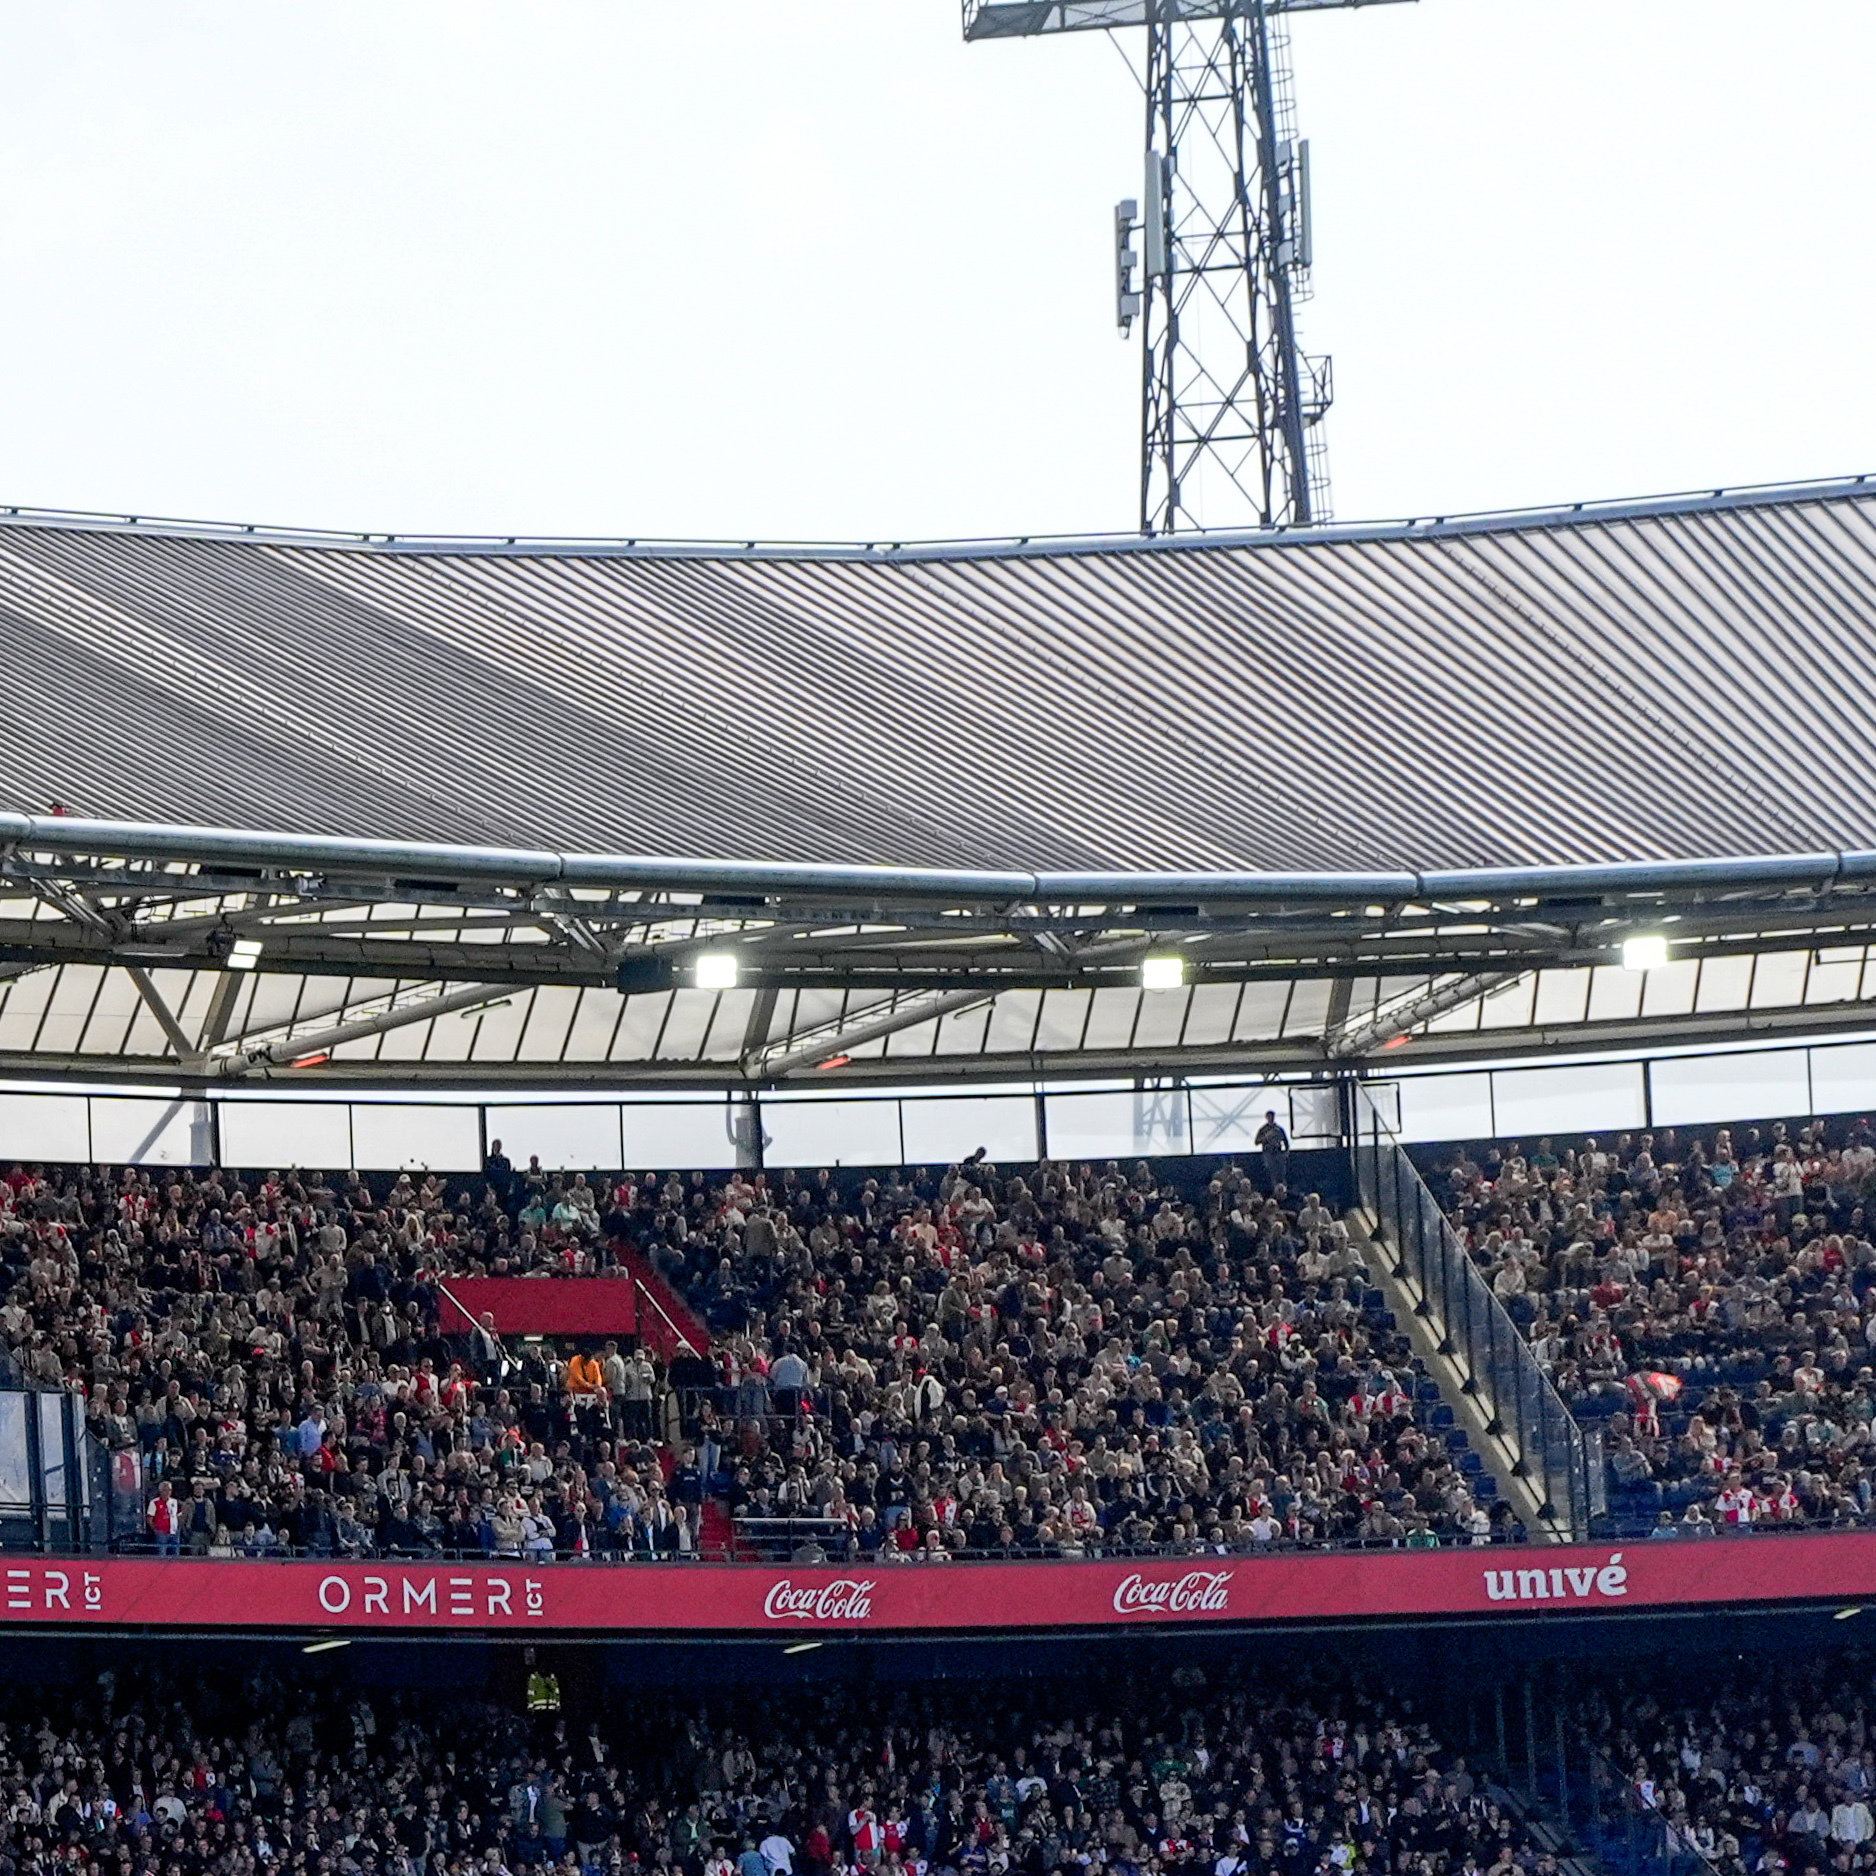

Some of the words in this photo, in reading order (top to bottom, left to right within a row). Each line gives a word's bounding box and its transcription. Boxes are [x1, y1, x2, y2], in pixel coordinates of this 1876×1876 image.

[318, 1576, 513, 1615] ORMER
[764, 1578, 872, 1620] Coca-Cola
[1114, 1570, 1234, 1613] Coca-Cola
